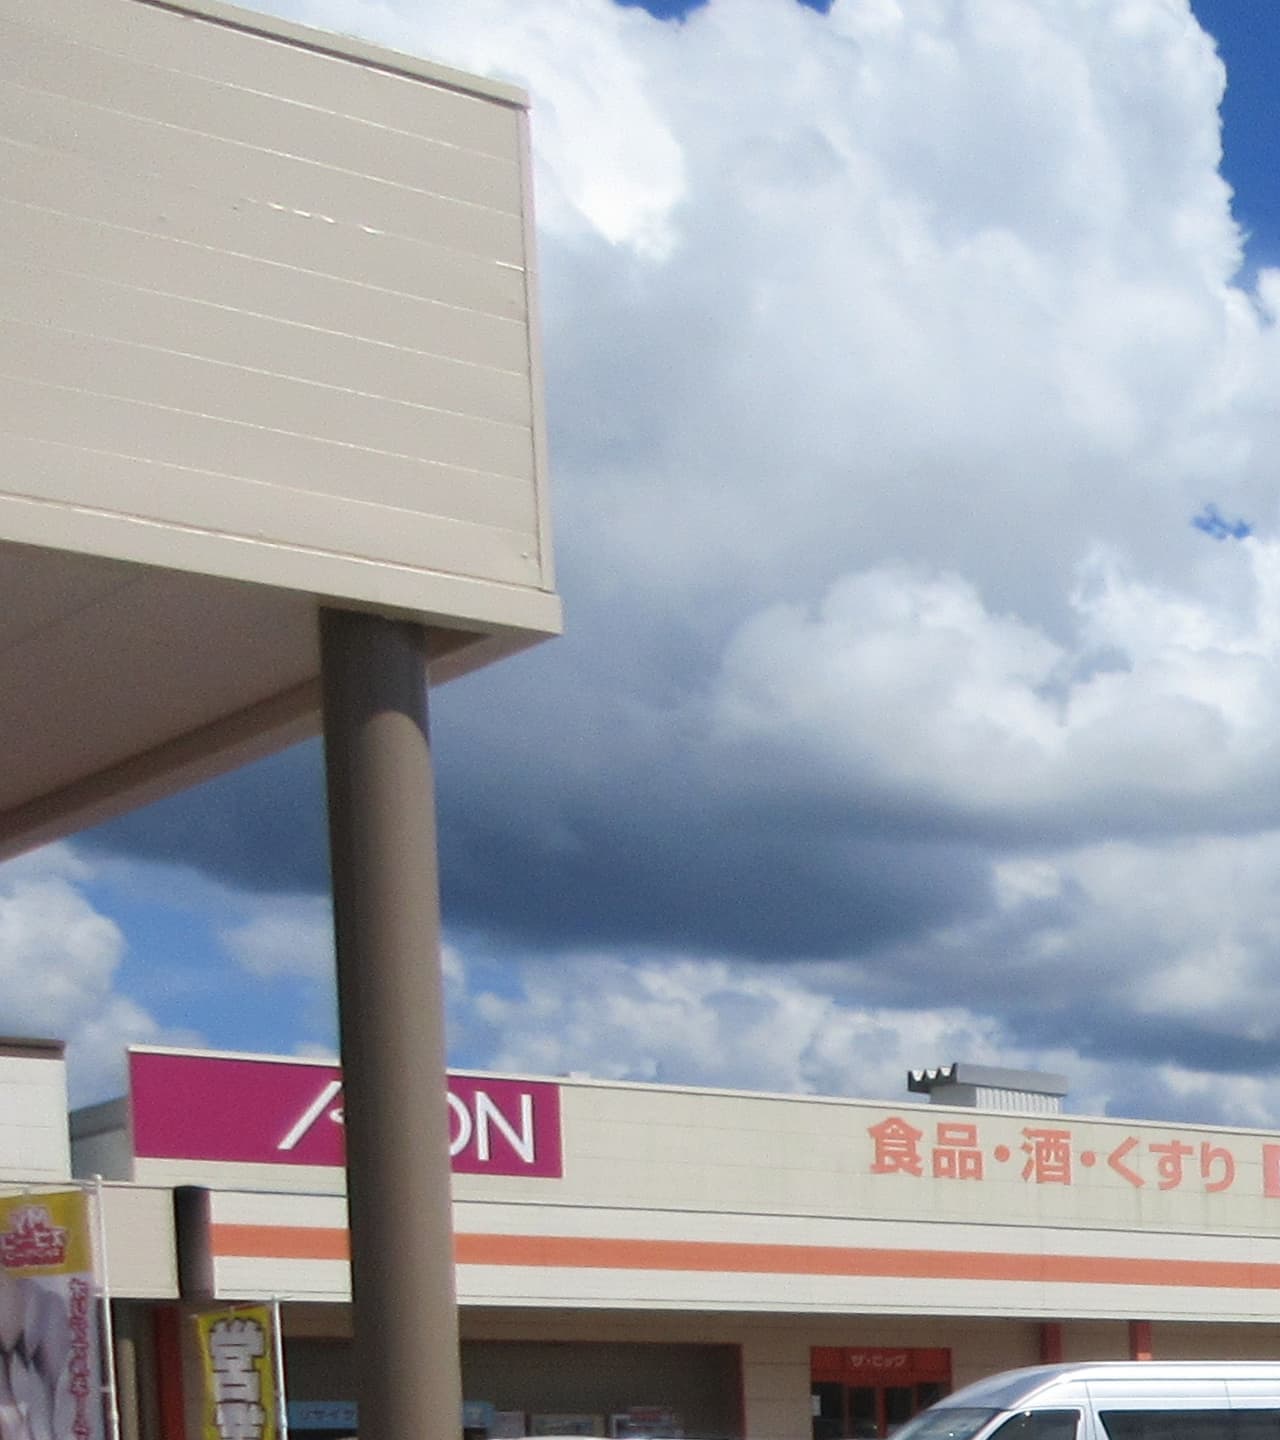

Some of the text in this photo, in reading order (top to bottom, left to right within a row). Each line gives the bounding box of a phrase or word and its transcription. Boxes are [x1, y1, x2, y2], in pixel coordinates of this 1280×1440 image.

[867, 1115, 1237, 1193] 食品・酒・くすり
